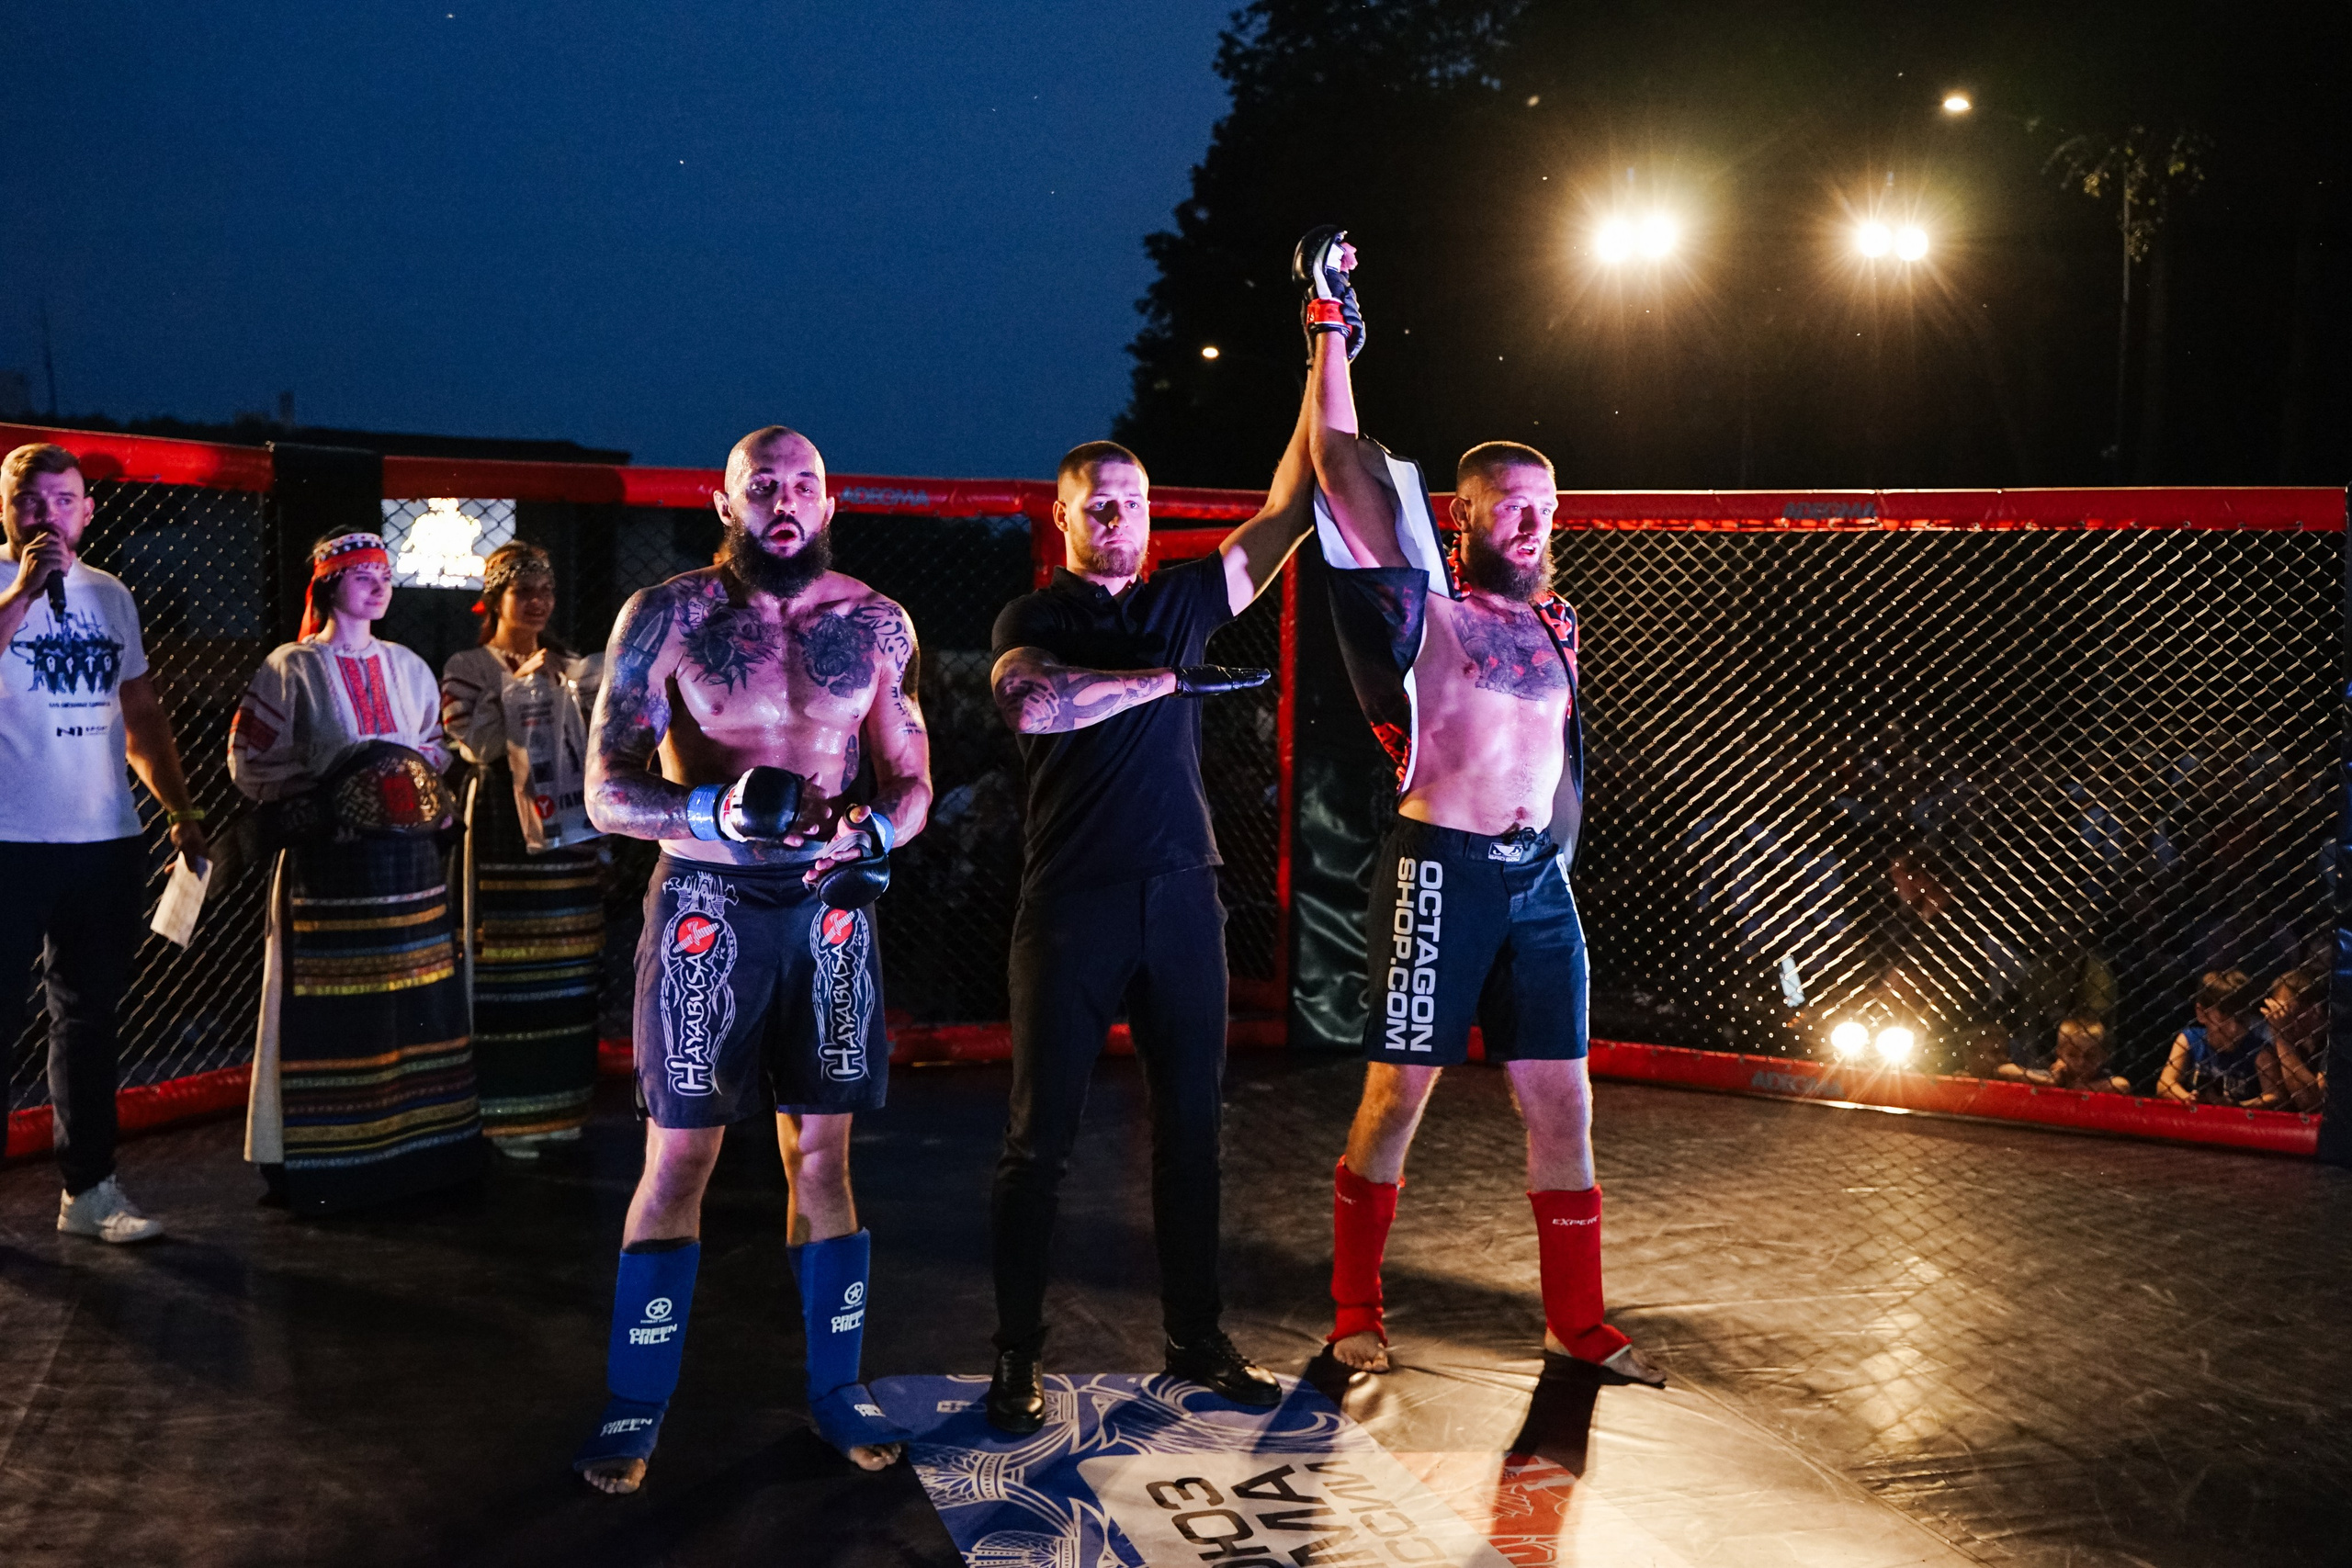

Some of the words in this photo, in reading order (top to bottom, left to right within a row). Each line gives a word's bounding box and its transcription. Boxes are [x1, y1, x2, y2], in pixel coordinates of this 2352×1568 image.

[1385, 856, 1416, 1051] SHOP.COM
[1410, 860, 1443, 1053] OCTAGON
[670, 949, 709, 1090] HAYABUSA
[823, 939, 862, 1076] HAYABUSA
[629, 1324, 678, 1336] GREEN
[629, 1332, 671, 1345] HILL
[1146, 1477, 1292, 1568] ЮЗ
[1230, 1464, 1387, 1568] МА
[1304, 1461, 1461, 1568] ССИИ
